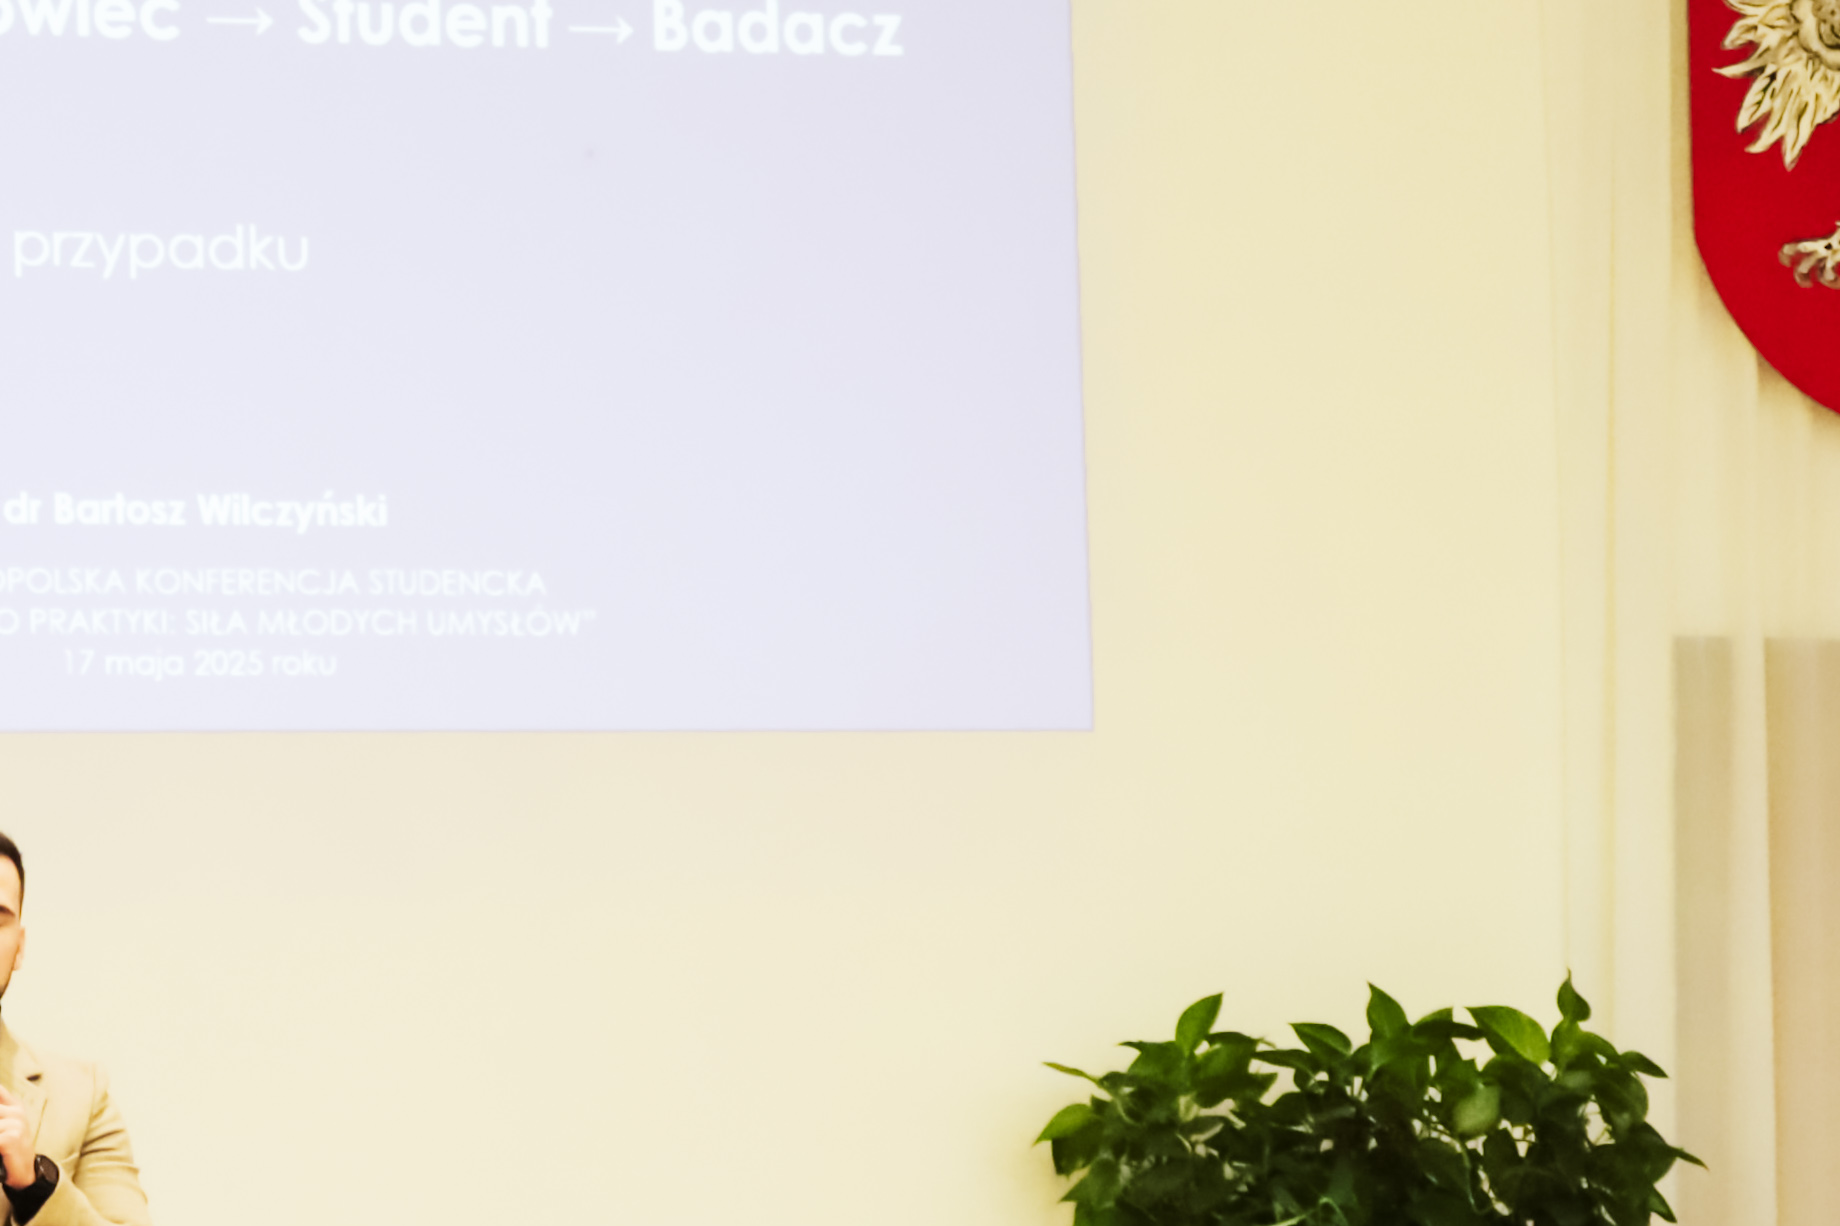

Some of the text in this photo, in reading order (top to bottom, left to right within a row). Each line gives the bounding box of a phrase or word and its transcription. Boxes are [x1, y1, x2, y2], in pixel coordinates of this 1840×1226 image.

[297, 0, 553, 48] Student
[652, 0, 904, 56] Badacz
[13, 223, 309, 280] przypadku
[3, 490, 388, 534] dr Bartosz Wilczyński
[135, 568, 360, 596] KONFERENCJA
[368, 568, 548, 597] STUDENCKA
[29, 606, 176, 636] PRAKTYKI:
[186, 609, 248, 636] SIŁA
[258, 608, 417, 637] MŁODYCH
[63, 648, 338, 683] 17 maja 2025 roku
